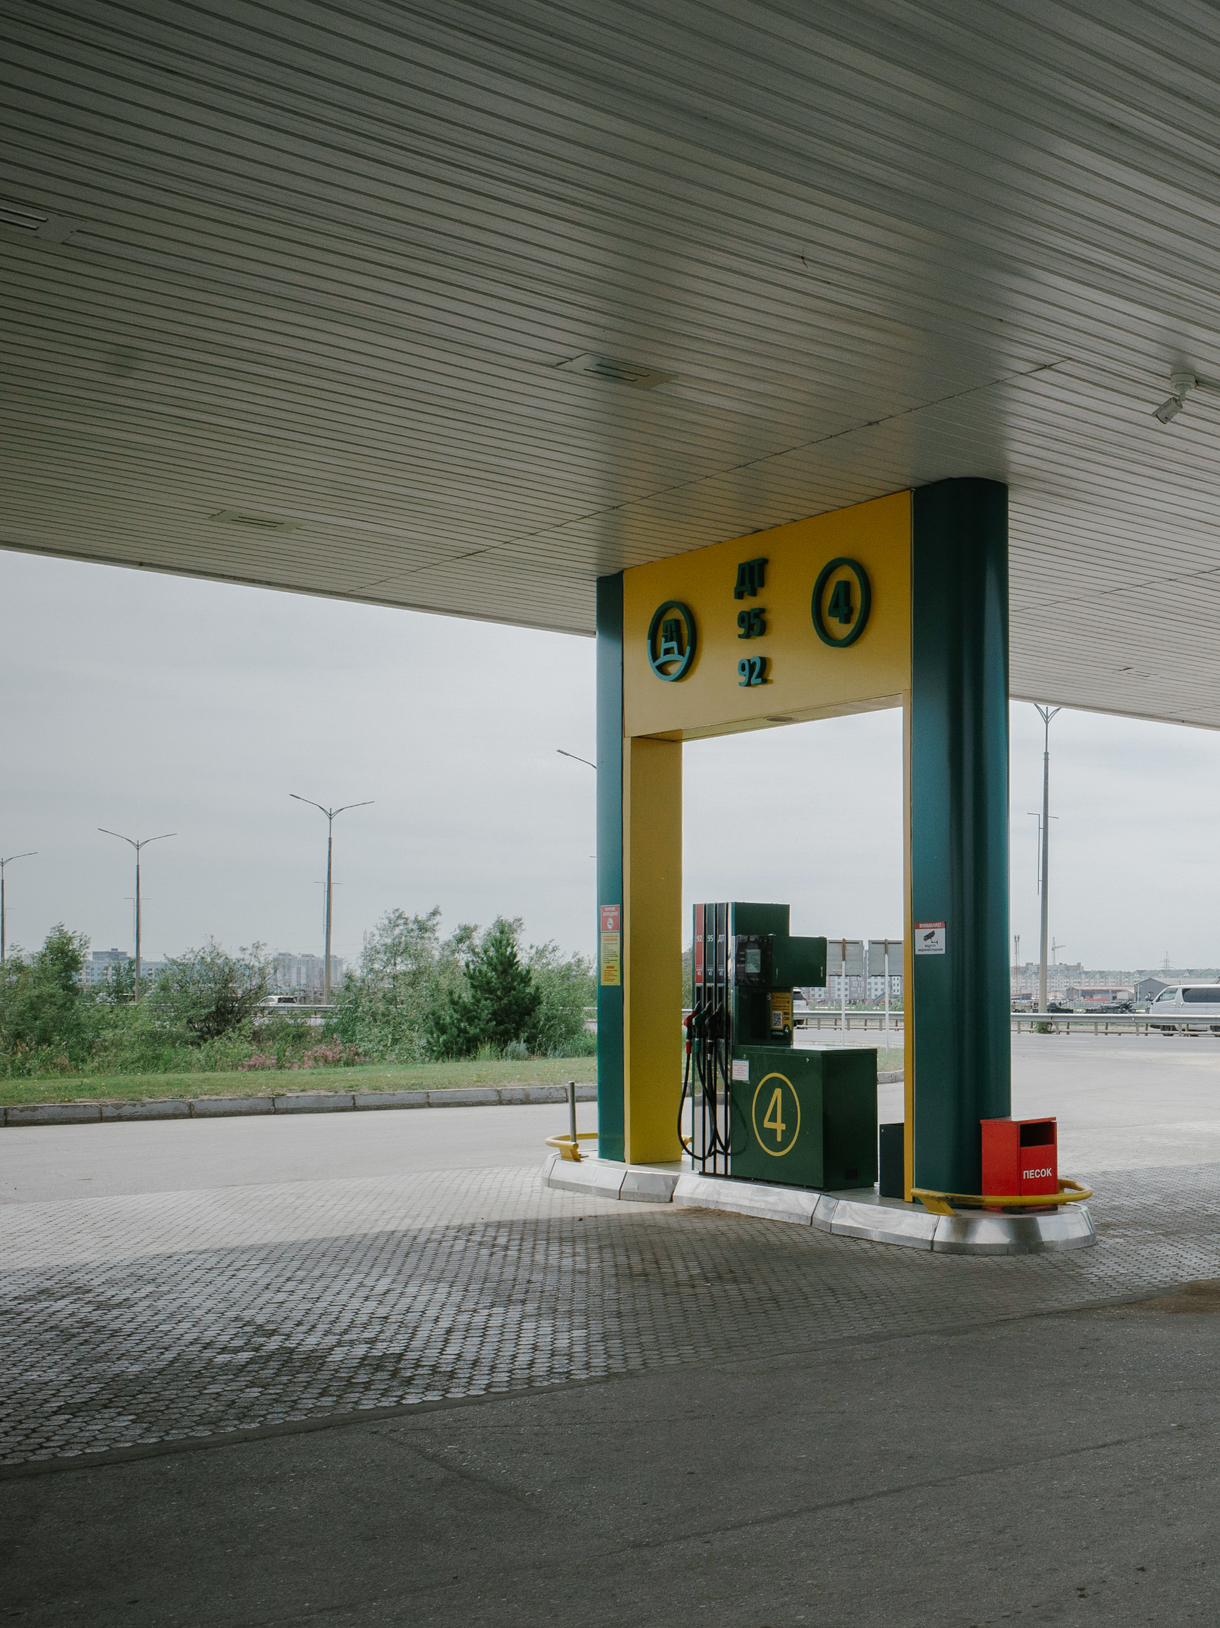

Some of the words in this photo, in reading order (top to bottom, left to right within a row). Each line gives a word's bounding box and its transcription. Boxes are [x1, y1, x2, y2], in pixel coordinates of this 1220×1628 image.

[734, 557, 768, 600] ДТ
[828, 580, 853, 625] 4
[737, 607, 766, 639] 95
[738, 656, 767, 687] 92
[763, 1088, 786, 1142] 4
[1023, 1167, 1052, 1179] ПЕСОК
